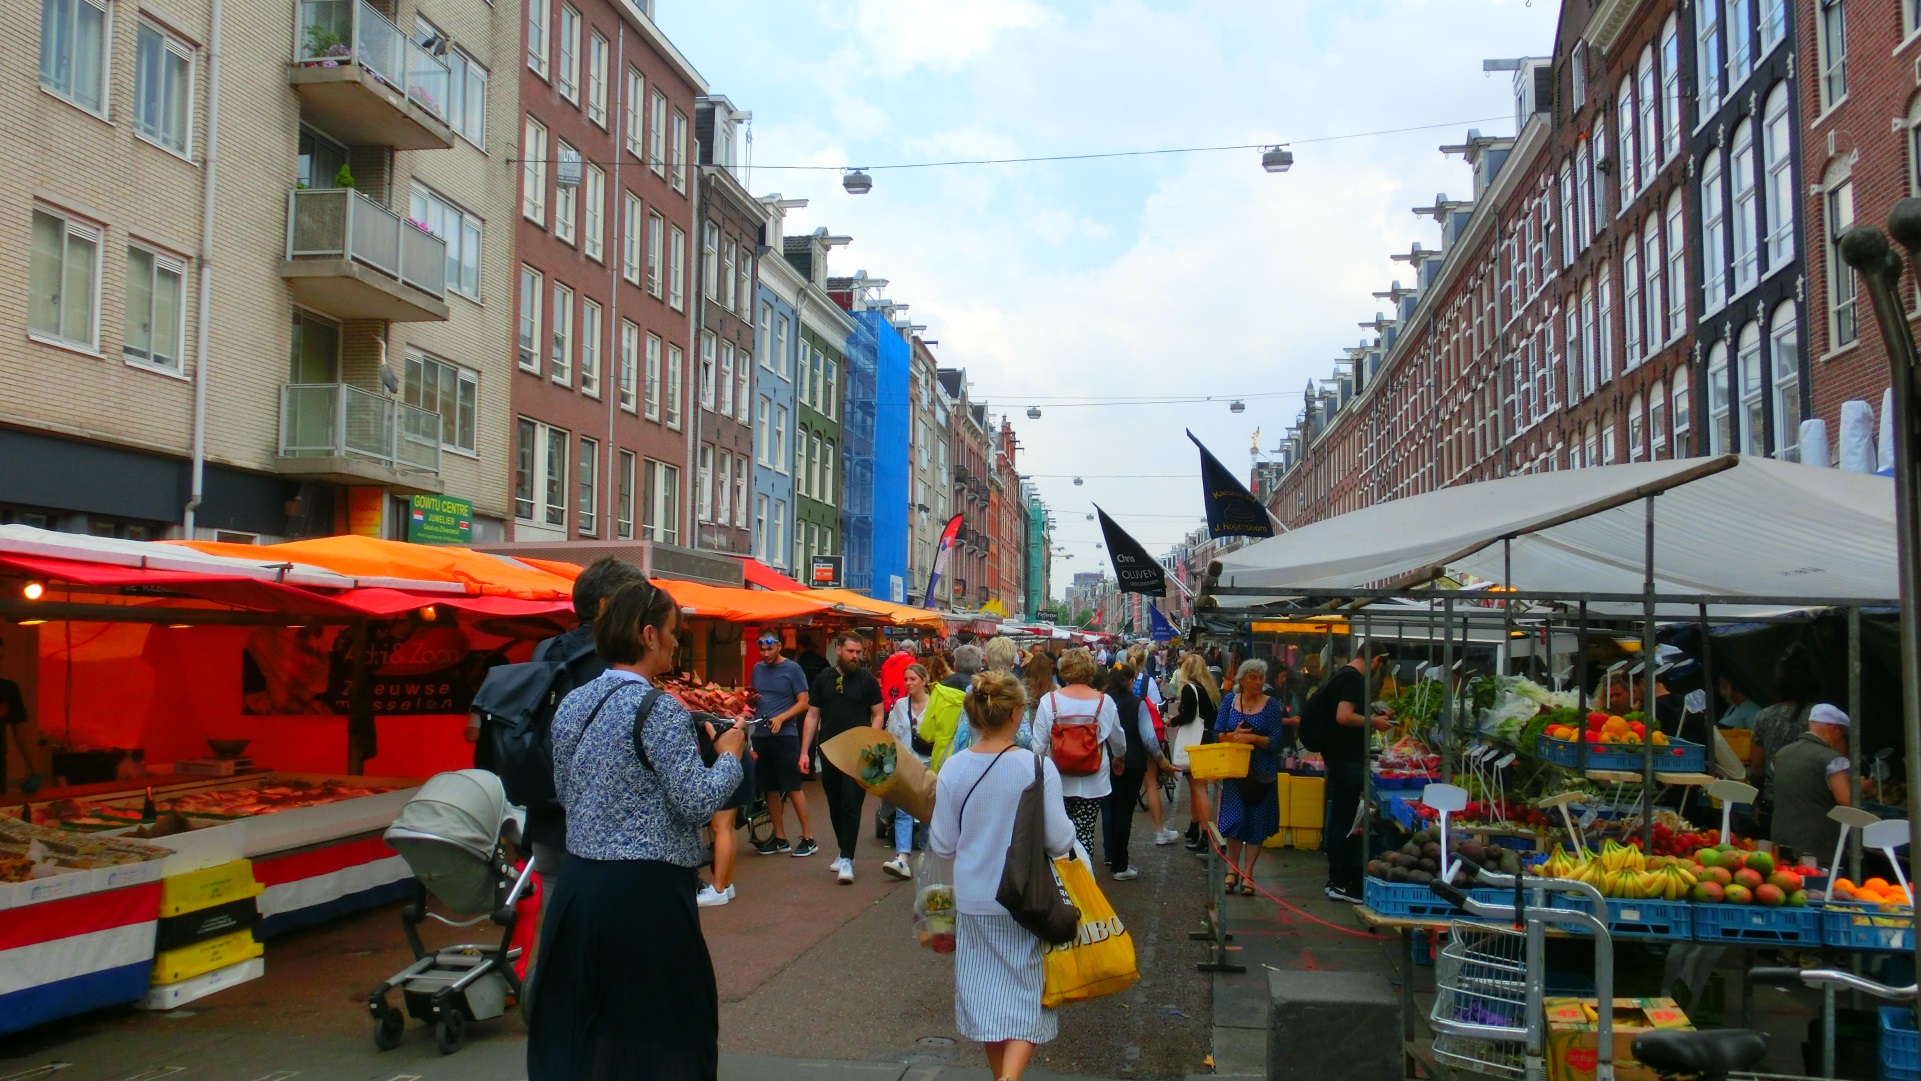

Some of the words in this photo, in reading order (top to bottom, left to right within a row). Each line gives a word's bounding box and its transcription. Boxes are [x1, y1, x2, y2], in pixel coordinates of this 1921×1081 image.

[413, 494, 441, 511] GOWTU
[441, 500, 469, 516] CENTRE
[427, 513, 455, 525] JUWELIER
[1116, 553, 1136, 563] Chris
[341, 680, 450, 696] Zeuwse
[335, 697, 453, 711] msselen
